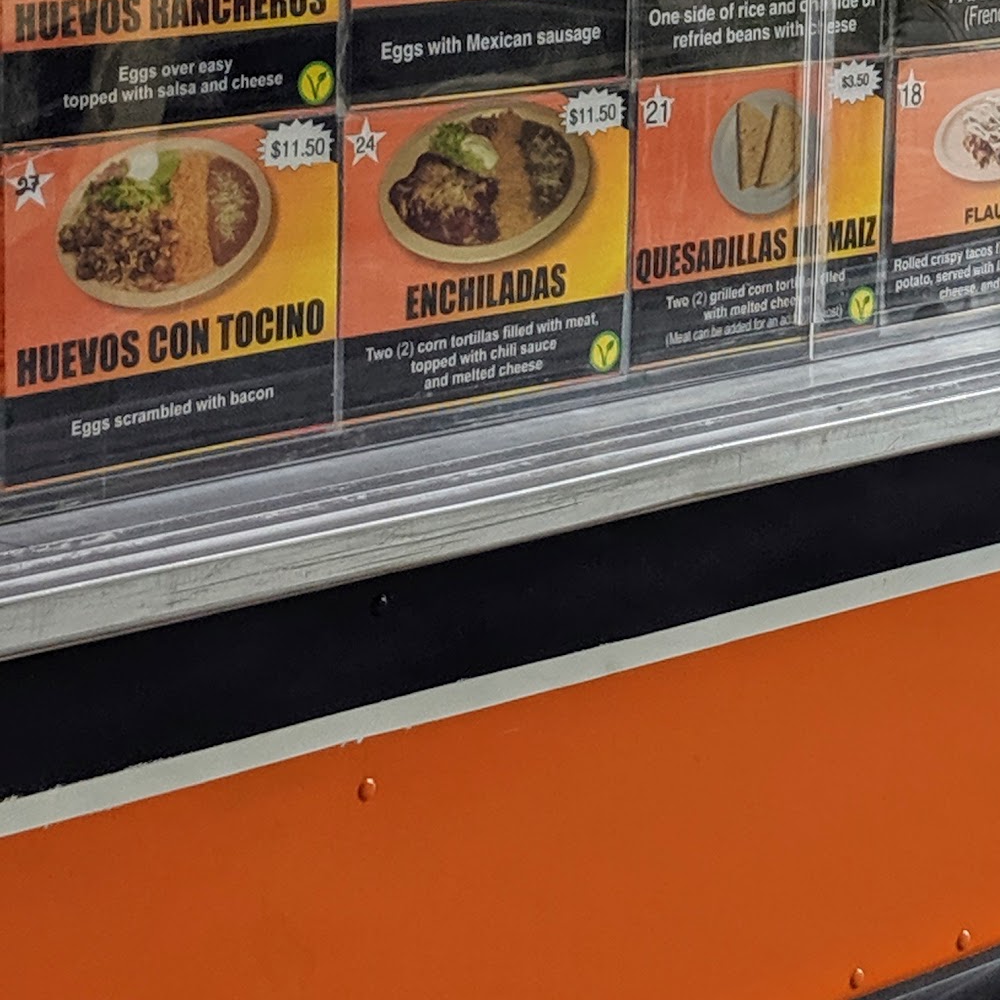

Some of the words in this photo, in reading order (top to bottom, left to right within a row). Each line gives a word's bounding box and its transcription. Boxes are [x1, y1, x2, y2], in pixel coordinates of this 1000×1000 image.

[649, 8, 681, 26] One
[684, 4, 715, 23] side
[719, 2, 735, 20] of
[738, 0, 766, 18] rice
[380, 40, 424, 64] Eggs
[428, 36, 462, 56] with
[466, 29, 532, 52] Mexican
[536, 24, 601, 49] sausage
[118, 65, 157, 85] Eggs
[161, 61, 195, 78] over
[198, 57, 233, 75] easy
[842, 73, 869, 88] $3.50
[63, 85, 118, 110] topped
[122, 86, 153, 102] with
[158, 79, 196, 98] salsa
[200, 77, 228, 94] and
[231, 73, 284, 90] cheese
[902, 83, 922, 106] 18
[569, 104, 617, 125] $11.50
[646, 100, 668, 124] 21
[271, 138, 326, 160] $11.50
[356, 136, 376, 154] 24
[17, 175, 40, 197] 27
[636, 227, 787, 284] QUESADILLAS
[827, 215, 877, 252] MAIZ
[406, 263, 566, 320] ENCHILADAS
[17, 330, 140, 388] HUEVOS
[149, 318, 209, 363] CON
[217, 298, 324, 351] TOCINO
[71, 417, 111, 439] Eggs
[114, 401, 192, 429] scrambled
[195, 394, 226, 412] with
[230, 386, 274, 407] bacon
